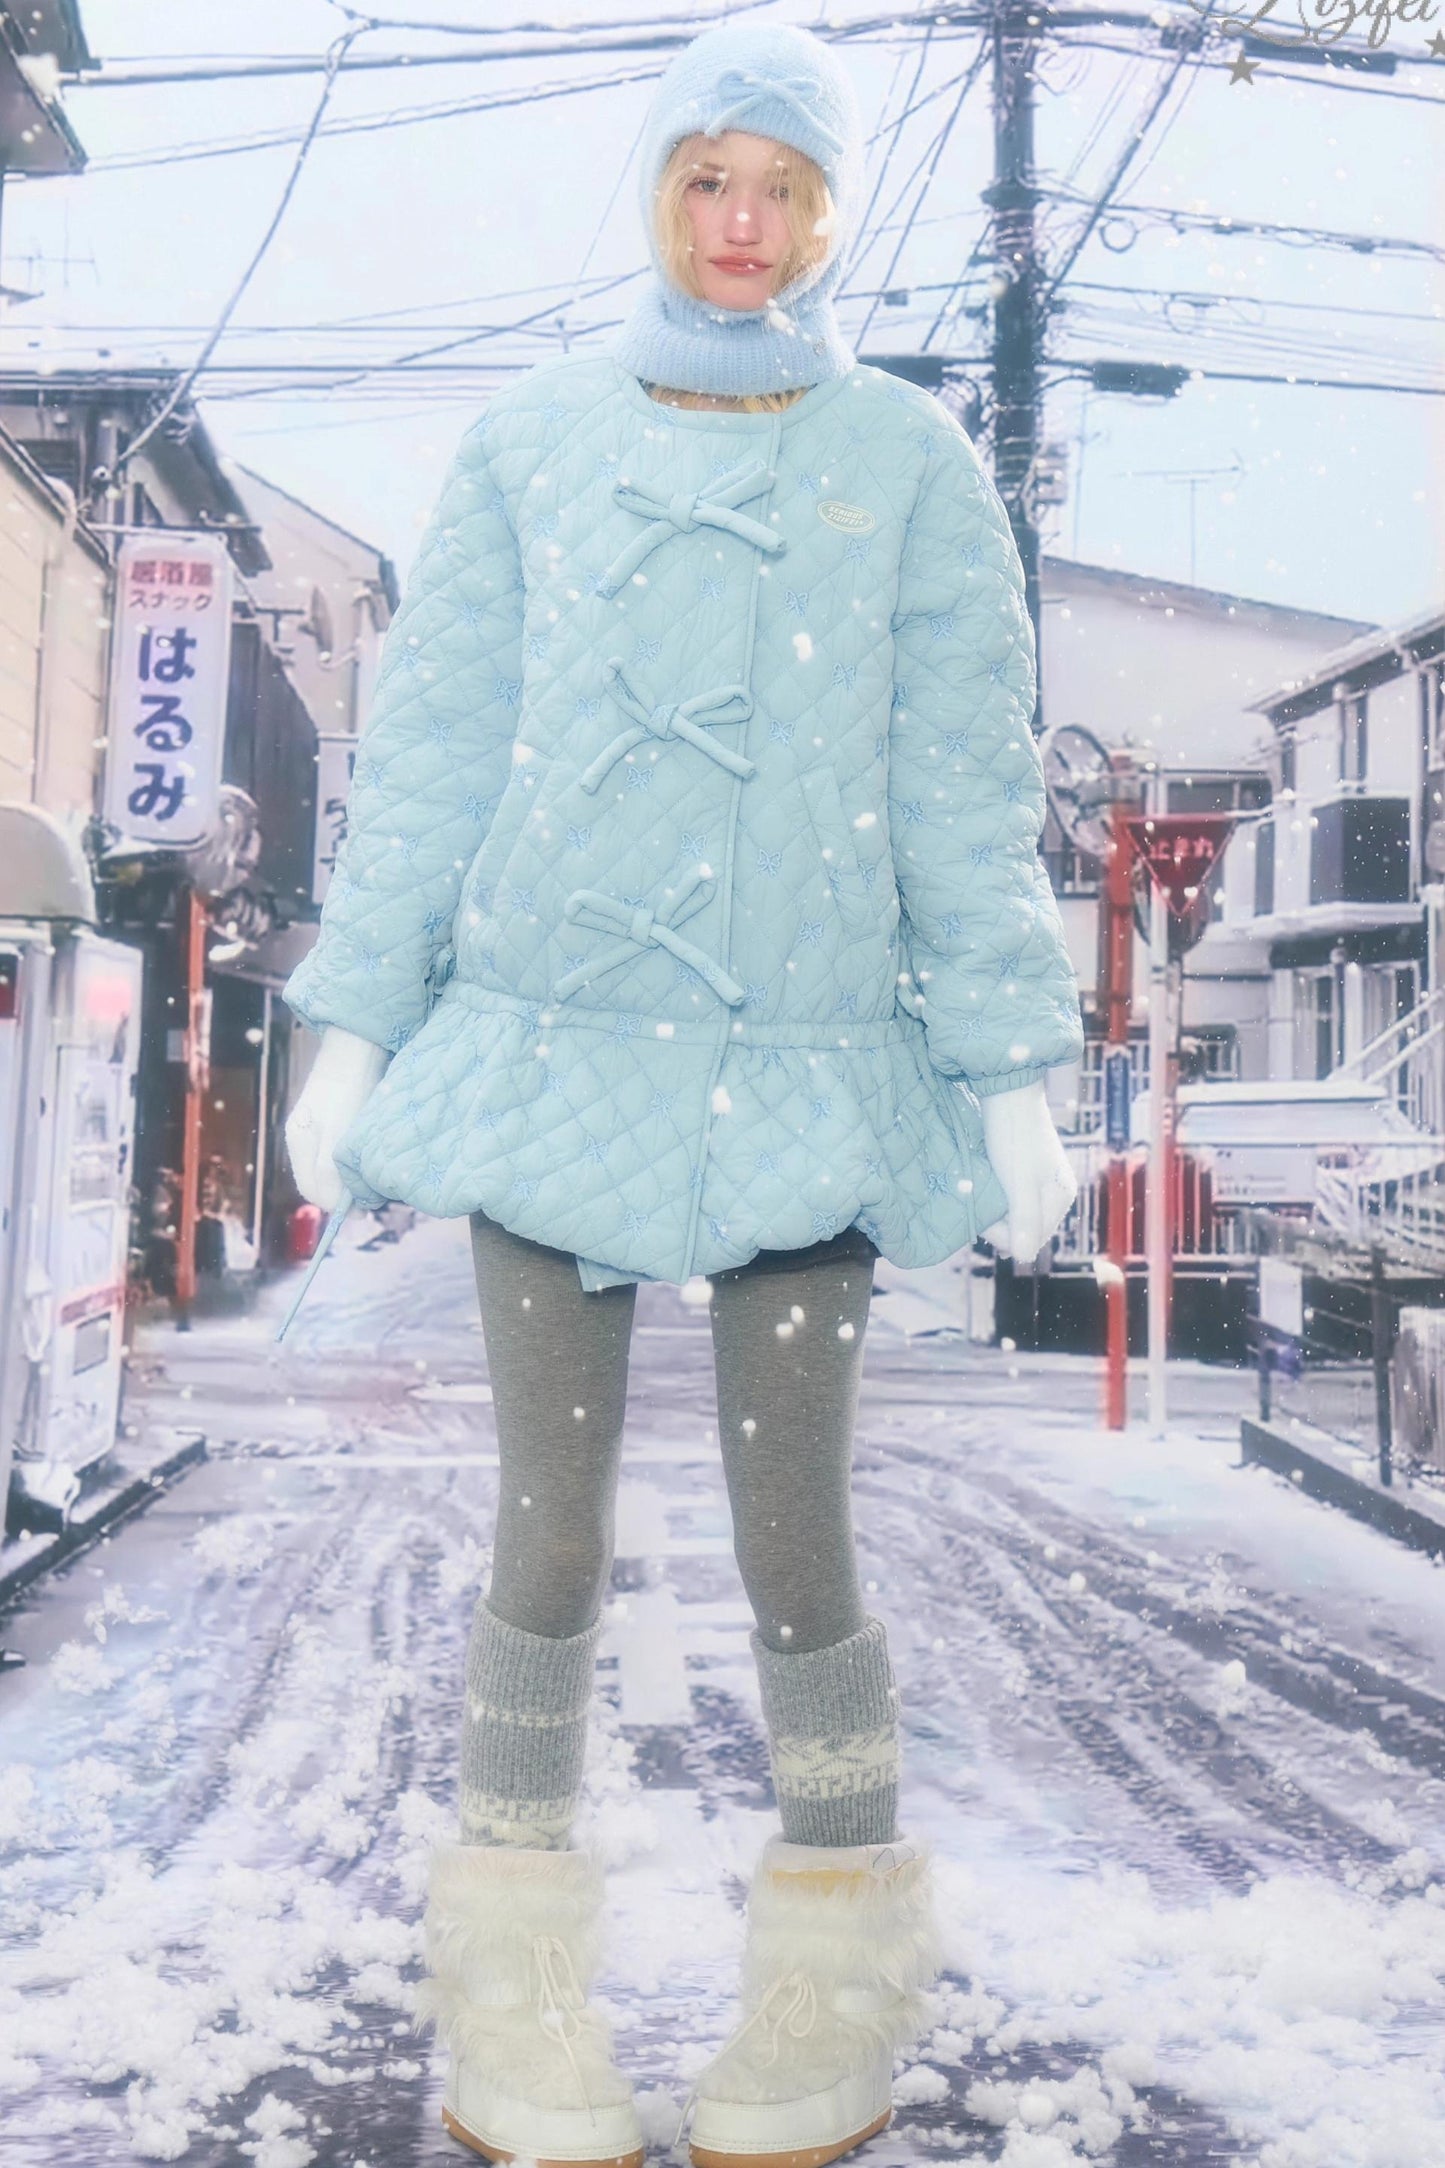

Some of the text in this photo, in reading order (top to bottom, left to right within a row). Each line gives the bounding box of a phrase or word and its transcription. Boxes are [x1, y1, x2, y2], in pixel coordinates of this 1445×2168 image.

[128, 589, 211, 612] スナック
[128, 627, 197, 821] はるみ
